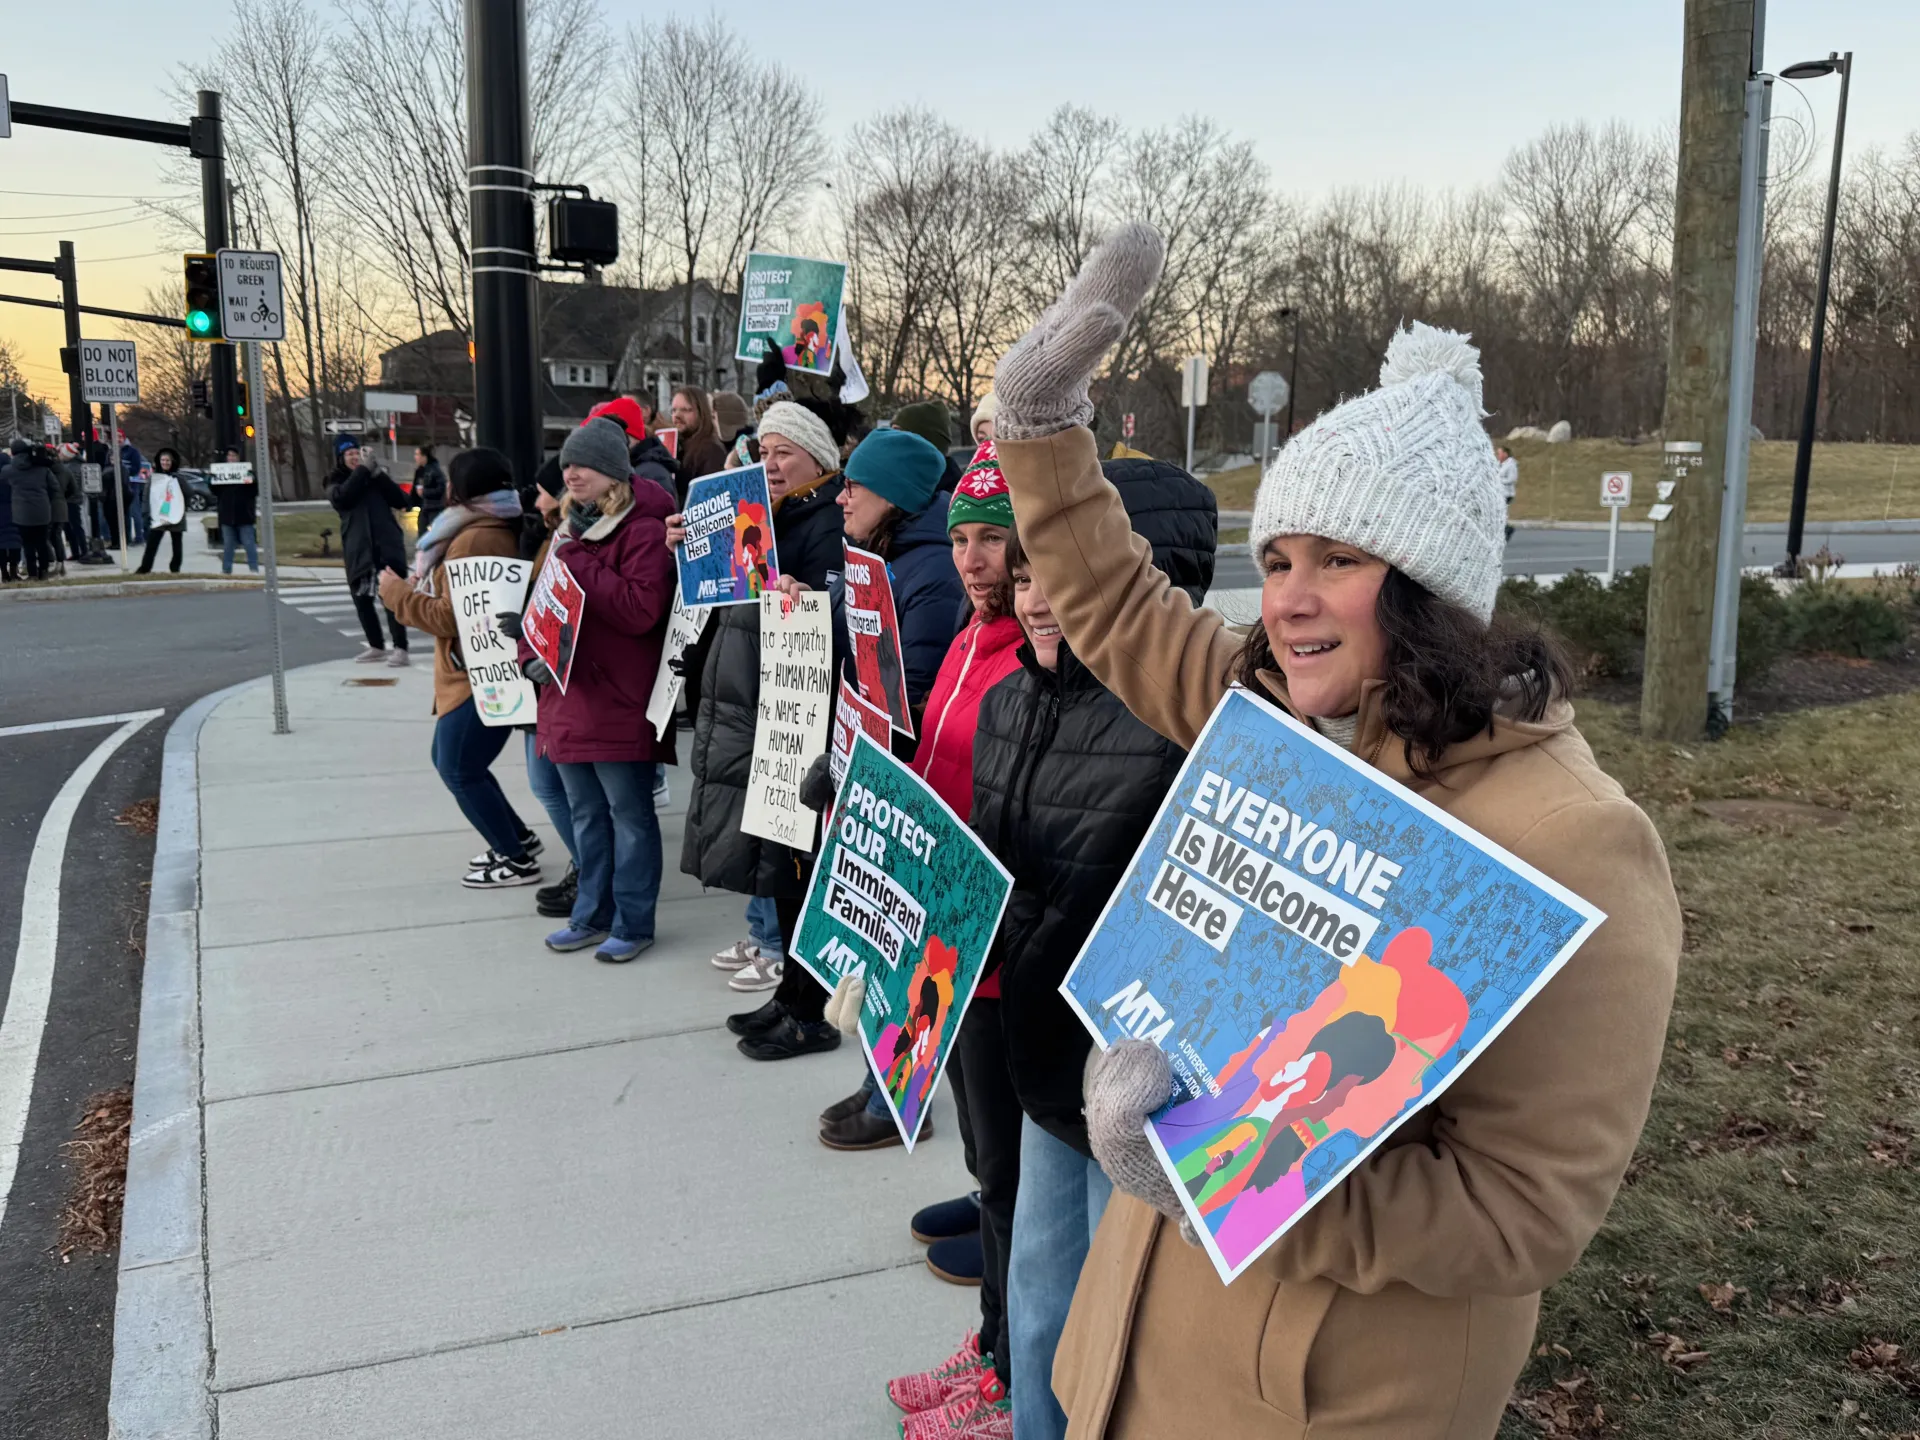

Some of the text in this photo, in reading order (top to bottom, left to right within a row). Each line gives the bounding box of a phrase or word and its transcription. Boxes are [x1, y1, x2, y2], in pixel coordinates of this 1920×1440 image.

[224, 258, 275, 271] TO REQUEST
[749, 269, 792, 285] PROTECT
[237, 274, 265, 286] GREEN
[748, 286, 766, 299] OUR
[228, 296, 248, 308] WAIT
[748, 300, 789, 316] Immigrant
[233, 311, 246, 322] ON
[747, 316, 777, 330] Families
[83, 347, 133, 363] DO NOT
[85, 368, 135, 383] BLOCK
[85, 386, 136, 397] INTERSECTION
[681, 490, 732, 527] EVERYONE
[684, 513, 734, 543] Is Welcome
[687, 542, 709, 559] Here
[449, 561, 522, 589] HANDS
[697, 579, 719, 599] MTA
[463, 590, 491, 617] OFF
[764, 593, 772, 615] If
[780, 598, 796, 620] you
[801, 594, 820, 613] have
[470, 630, 506, 653] OUR
[762, 631, 776, 649] no
[781, 625, 827, 665] sympathy
[760, 662, 772, 684] for
[775, 662, 806, 692] HUMAN
[807, 665, 831, 696] PAIN
[759, 698, 817, 728] the NAME of
[768, 729, 804, 756] HUMAN
[752, 756, 770, 785] you
[772, 757, 797, 786] shall
[764, 784, 798, 813] retain
[847, 780, 936, 866] PROTECT
[840, 815, 887, 867] OUR
[1189, 769, 1404, 911] EVERYONE
[836, 847, 922, 944] Immigrant
[1174, 817, 1362, 958] Is Welcome
[1152, 863, 1228, 941] Here
[829, 886, 900, 963] Families
[816, 935, 867, 980] MTA
[1101, 979, 1175, 1052] MTA
[1168, 1052, 1205, 1100] of EDUCATION
[1177, 1038, 1223, 1100] A DIVERSE UNION
